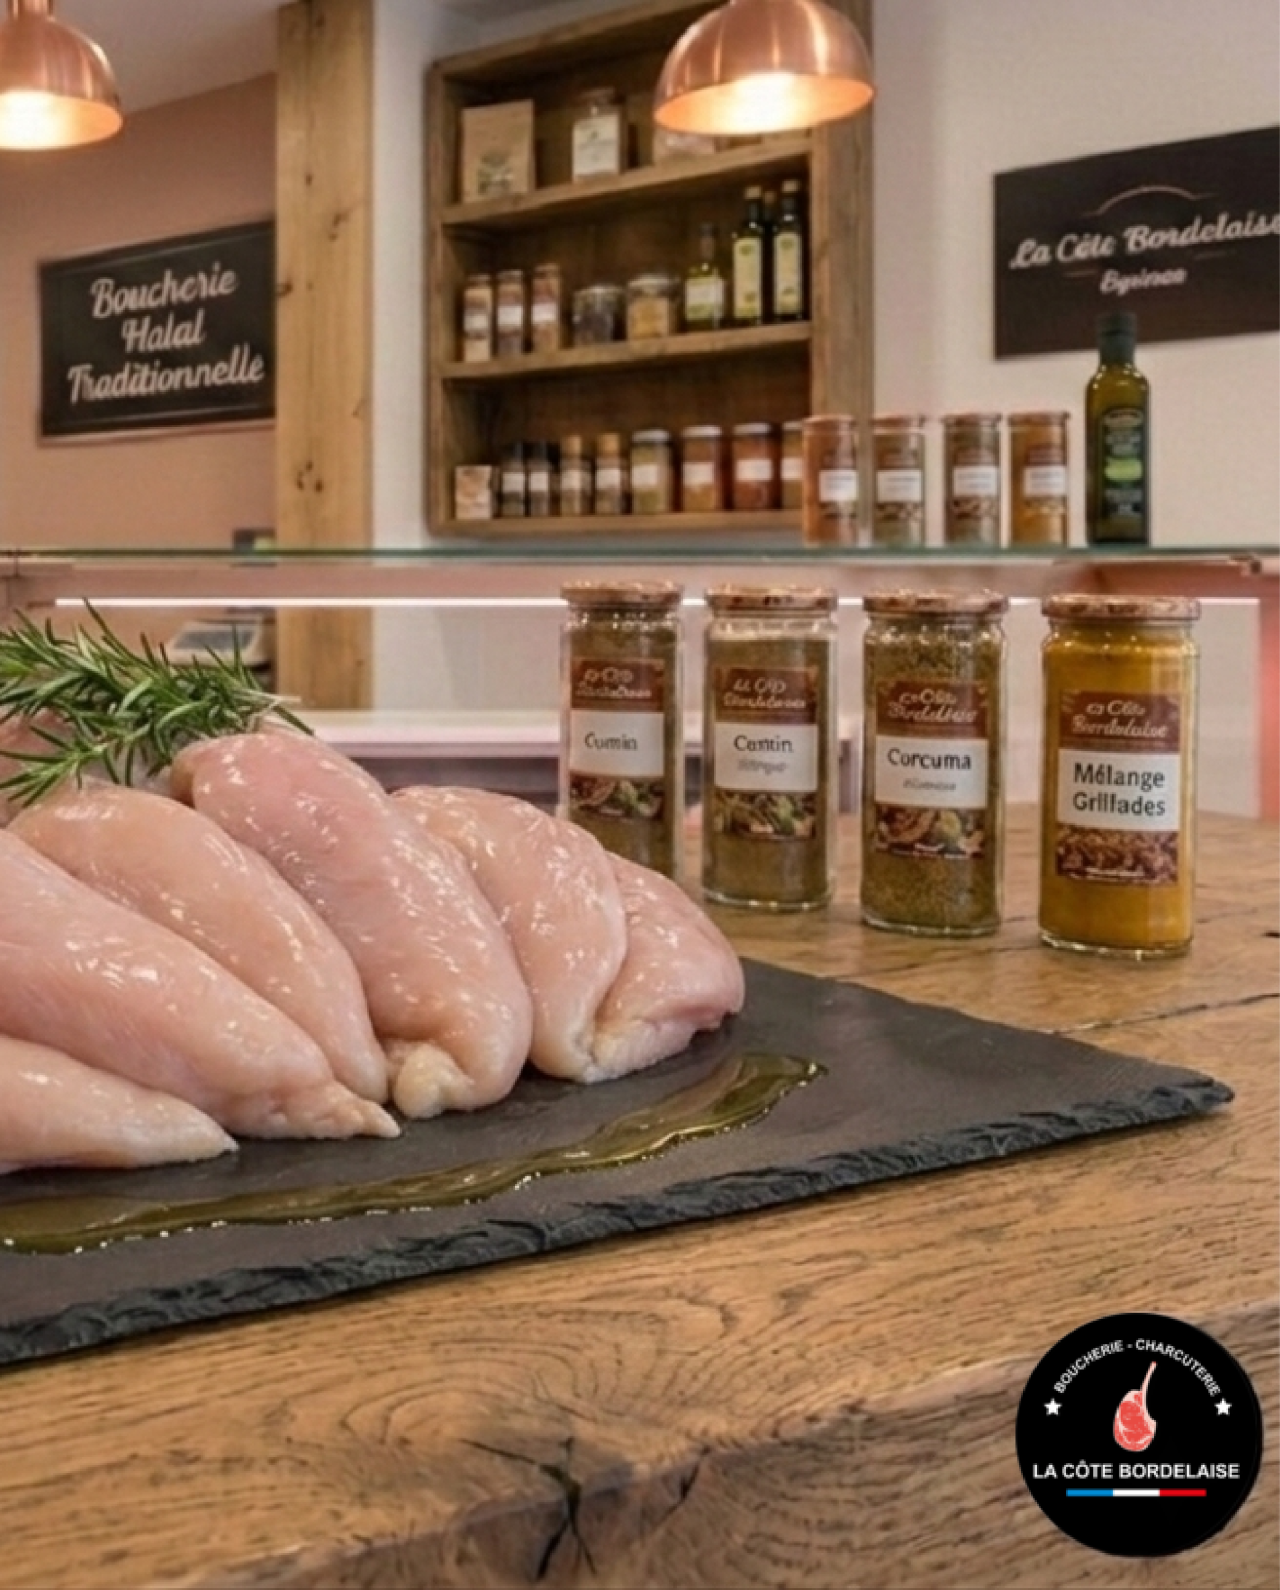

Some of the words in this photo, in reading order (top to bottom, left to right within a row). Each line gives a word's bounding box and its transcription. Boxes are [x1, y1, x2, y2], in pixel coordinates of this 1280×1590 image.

[90, 260, 238, 319] Boucherie
[121, 307, 206, 353] Halal
[67, 341, 266, 405] Traditionnelle
[1073, 762, 1166, 793] Mélange
